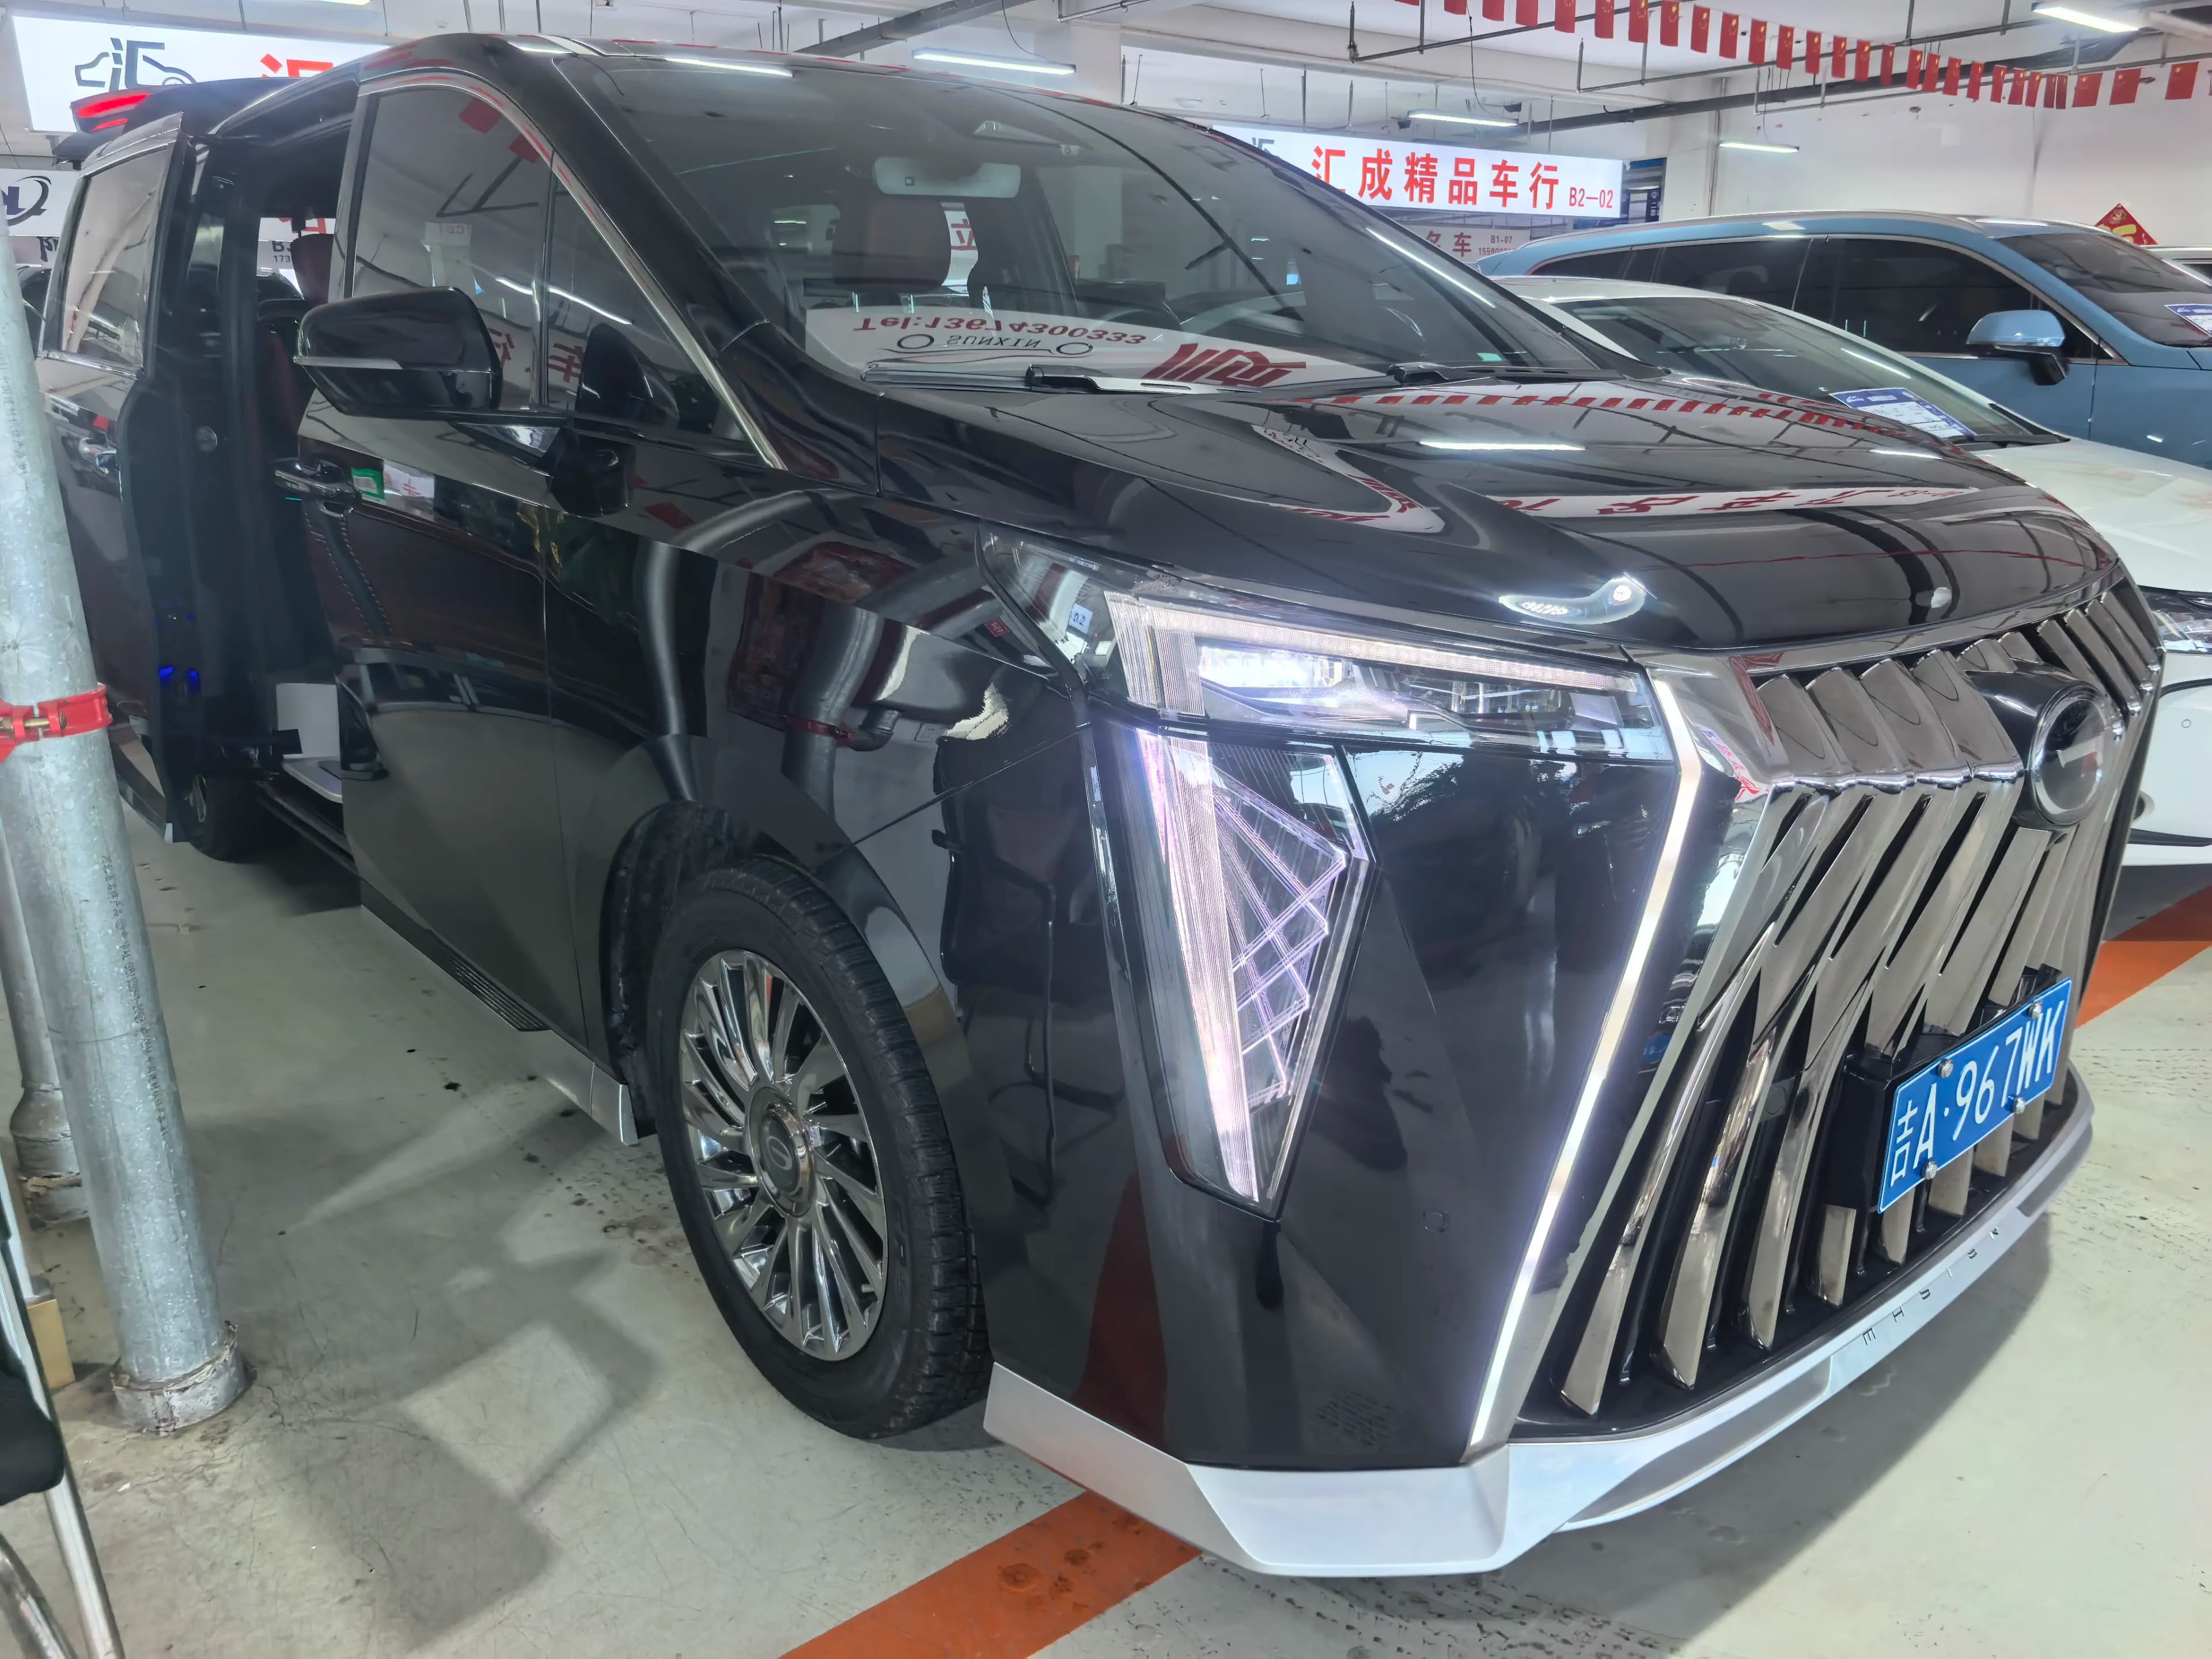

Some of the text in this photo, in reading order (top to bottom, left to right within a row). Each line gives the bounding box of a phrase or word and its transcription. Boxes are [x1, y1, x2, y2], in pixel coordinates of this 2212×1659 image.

[1311, 145, 1615, 210] 汇成精品车行 B2-02
[1490, 235, 1513, 244] B1-07
